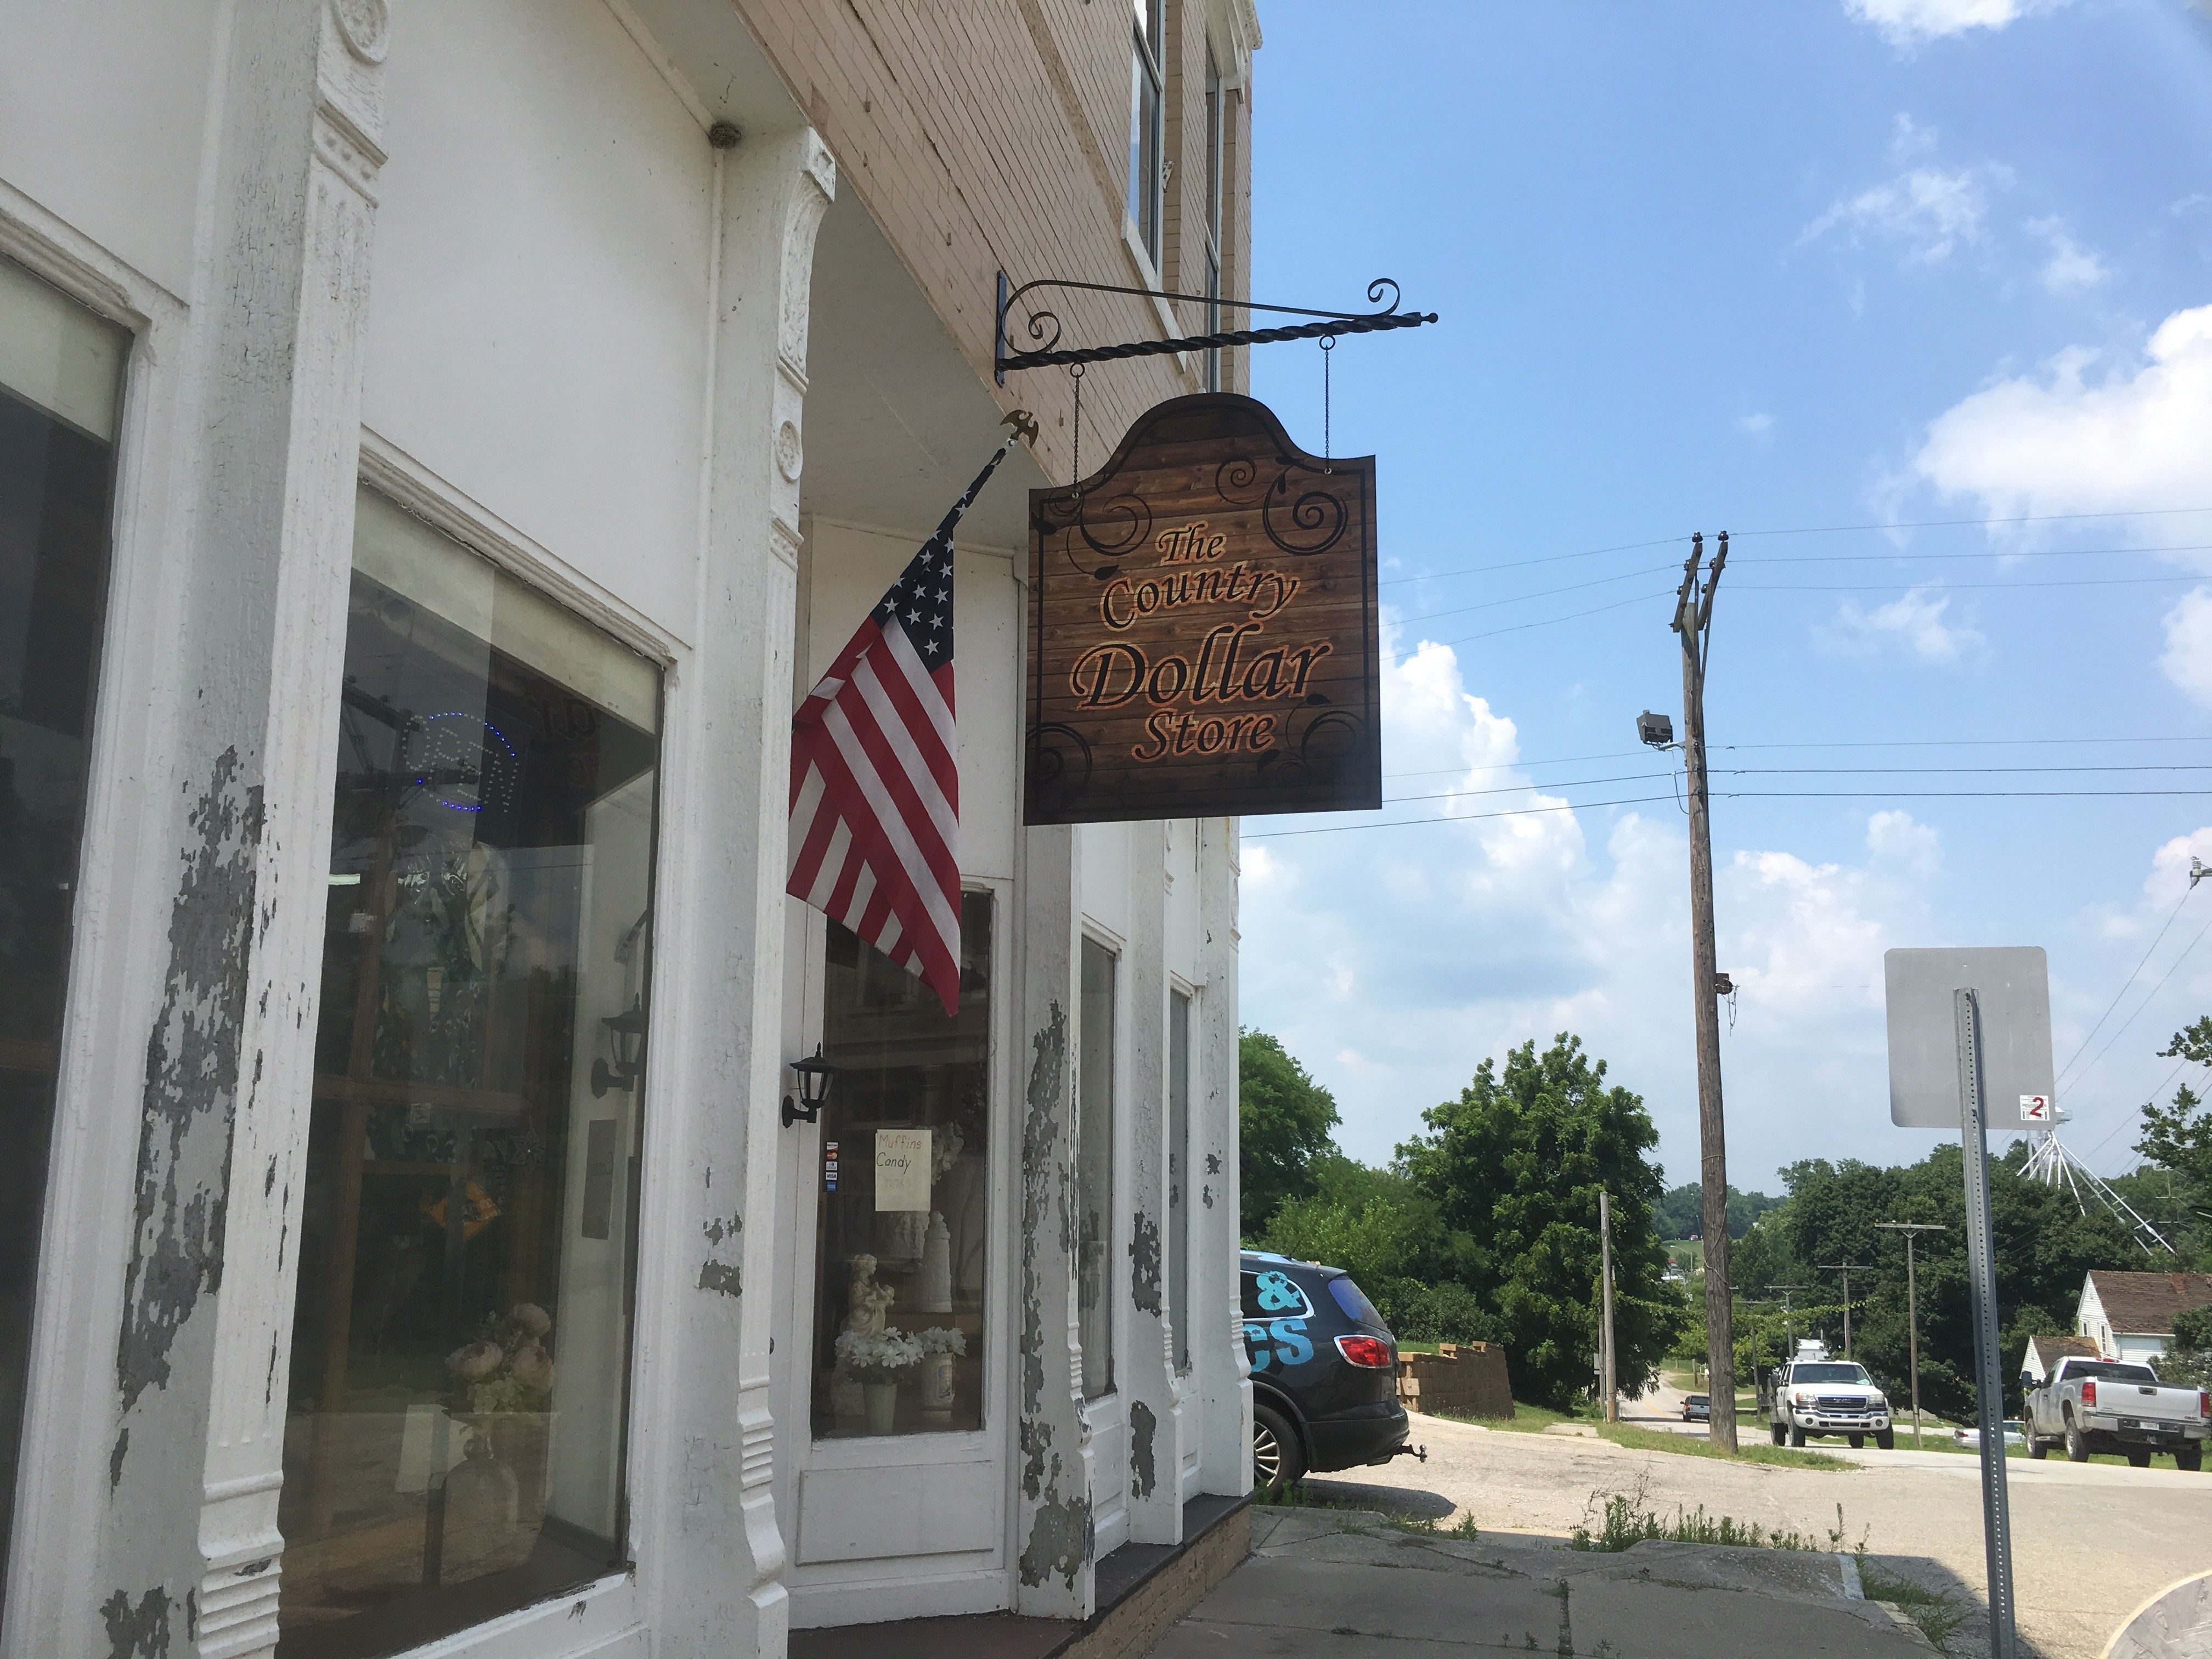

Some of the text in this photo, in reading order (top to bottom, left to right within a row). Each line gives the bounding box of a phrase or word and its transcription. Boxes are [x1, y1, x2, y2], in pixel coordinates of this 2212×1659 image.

[1155, 521, 1227, 566] The
[1101, 560, 1300, 632] Country
[1069, 622, 1334, 712] Dollar
[1131, 708, 1278, 763] Store
[402, 715, 519, 813] OPEN
[2030, 1097, 2044, 1118] 2
[877, 1152, 912, 1174] Candy
[879, 1135, 922, 1149] Muffins
[1256, 1271, 1302, 1310] &
